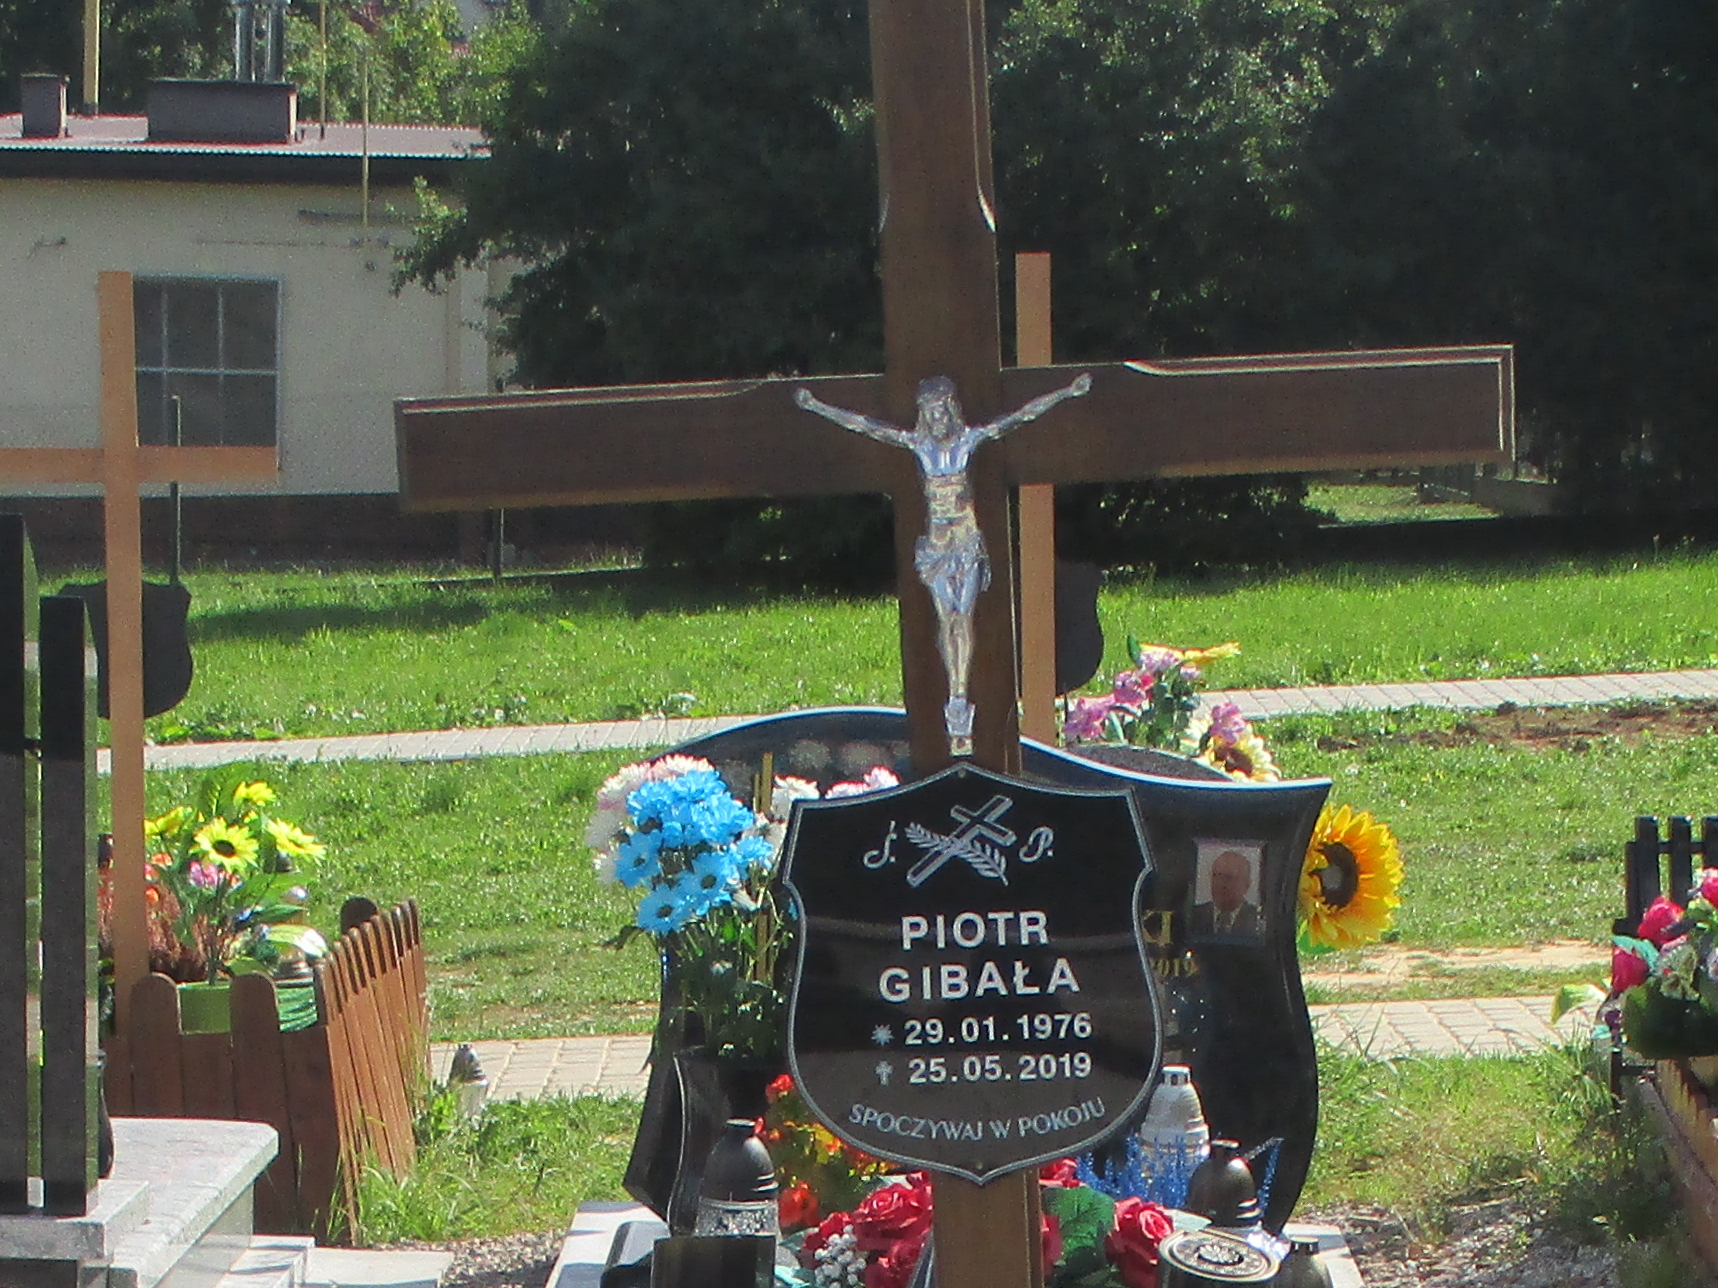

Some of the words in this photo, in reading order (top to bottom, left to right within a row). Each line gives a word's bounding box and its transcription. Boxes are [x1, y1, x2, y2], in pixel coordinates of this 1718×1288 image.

[1019, 826, 1055, 864] P.
[901, 909, 1049, 951] PIOTR
[879, 957, 1080, 1003] GIBAŁA
[903, 1011, 1094, 1046] 29.01.1976
[907, 1051, 1094, 1085] 25.05.2019
[847, 1103, 983, 1143] SPOCZYWAJ
[988, 1121, 1011, 1140] W
